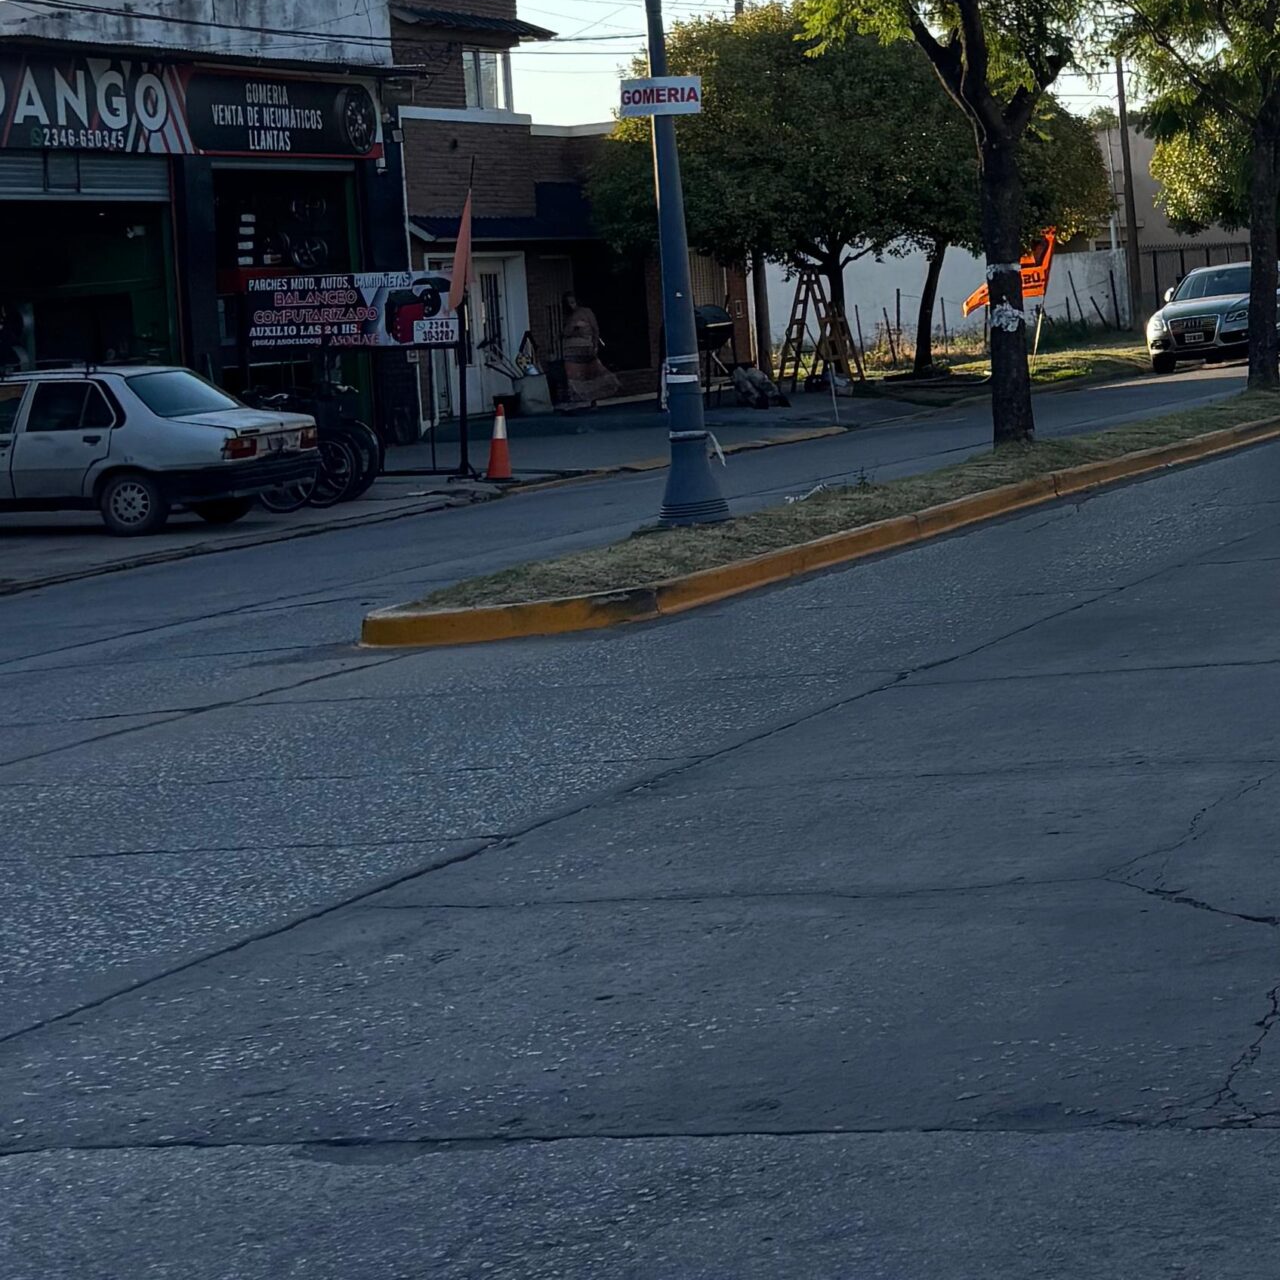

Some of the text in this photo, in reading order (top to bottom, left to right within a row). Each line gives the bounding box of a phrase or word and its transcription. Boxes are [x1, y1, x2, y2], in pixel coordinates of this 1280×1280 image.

[0, 66, 167, 131] ANGO
[621, 87, 699, 106] GOMERIA
[211, 104, 323, 130] VENTA DE NEUMÁTICOS
[43, 128, 125, 148] 2346-650345
[249, 129, 291, 151] LLANTAS
[248, 278, 288, 292] PARCHES
[290, 277, 318, 291] MOTO,
[320, 276, 351, 289] AUTOS,
[274, 290, 358, 307] BALANCEO
[254, 307, 378, 325] COMPUTARIZADO
[249, 325, 297, 337] AUXILIO
[300, 324, 322, 335] LAS
[324, 324, 338, 335] 24
